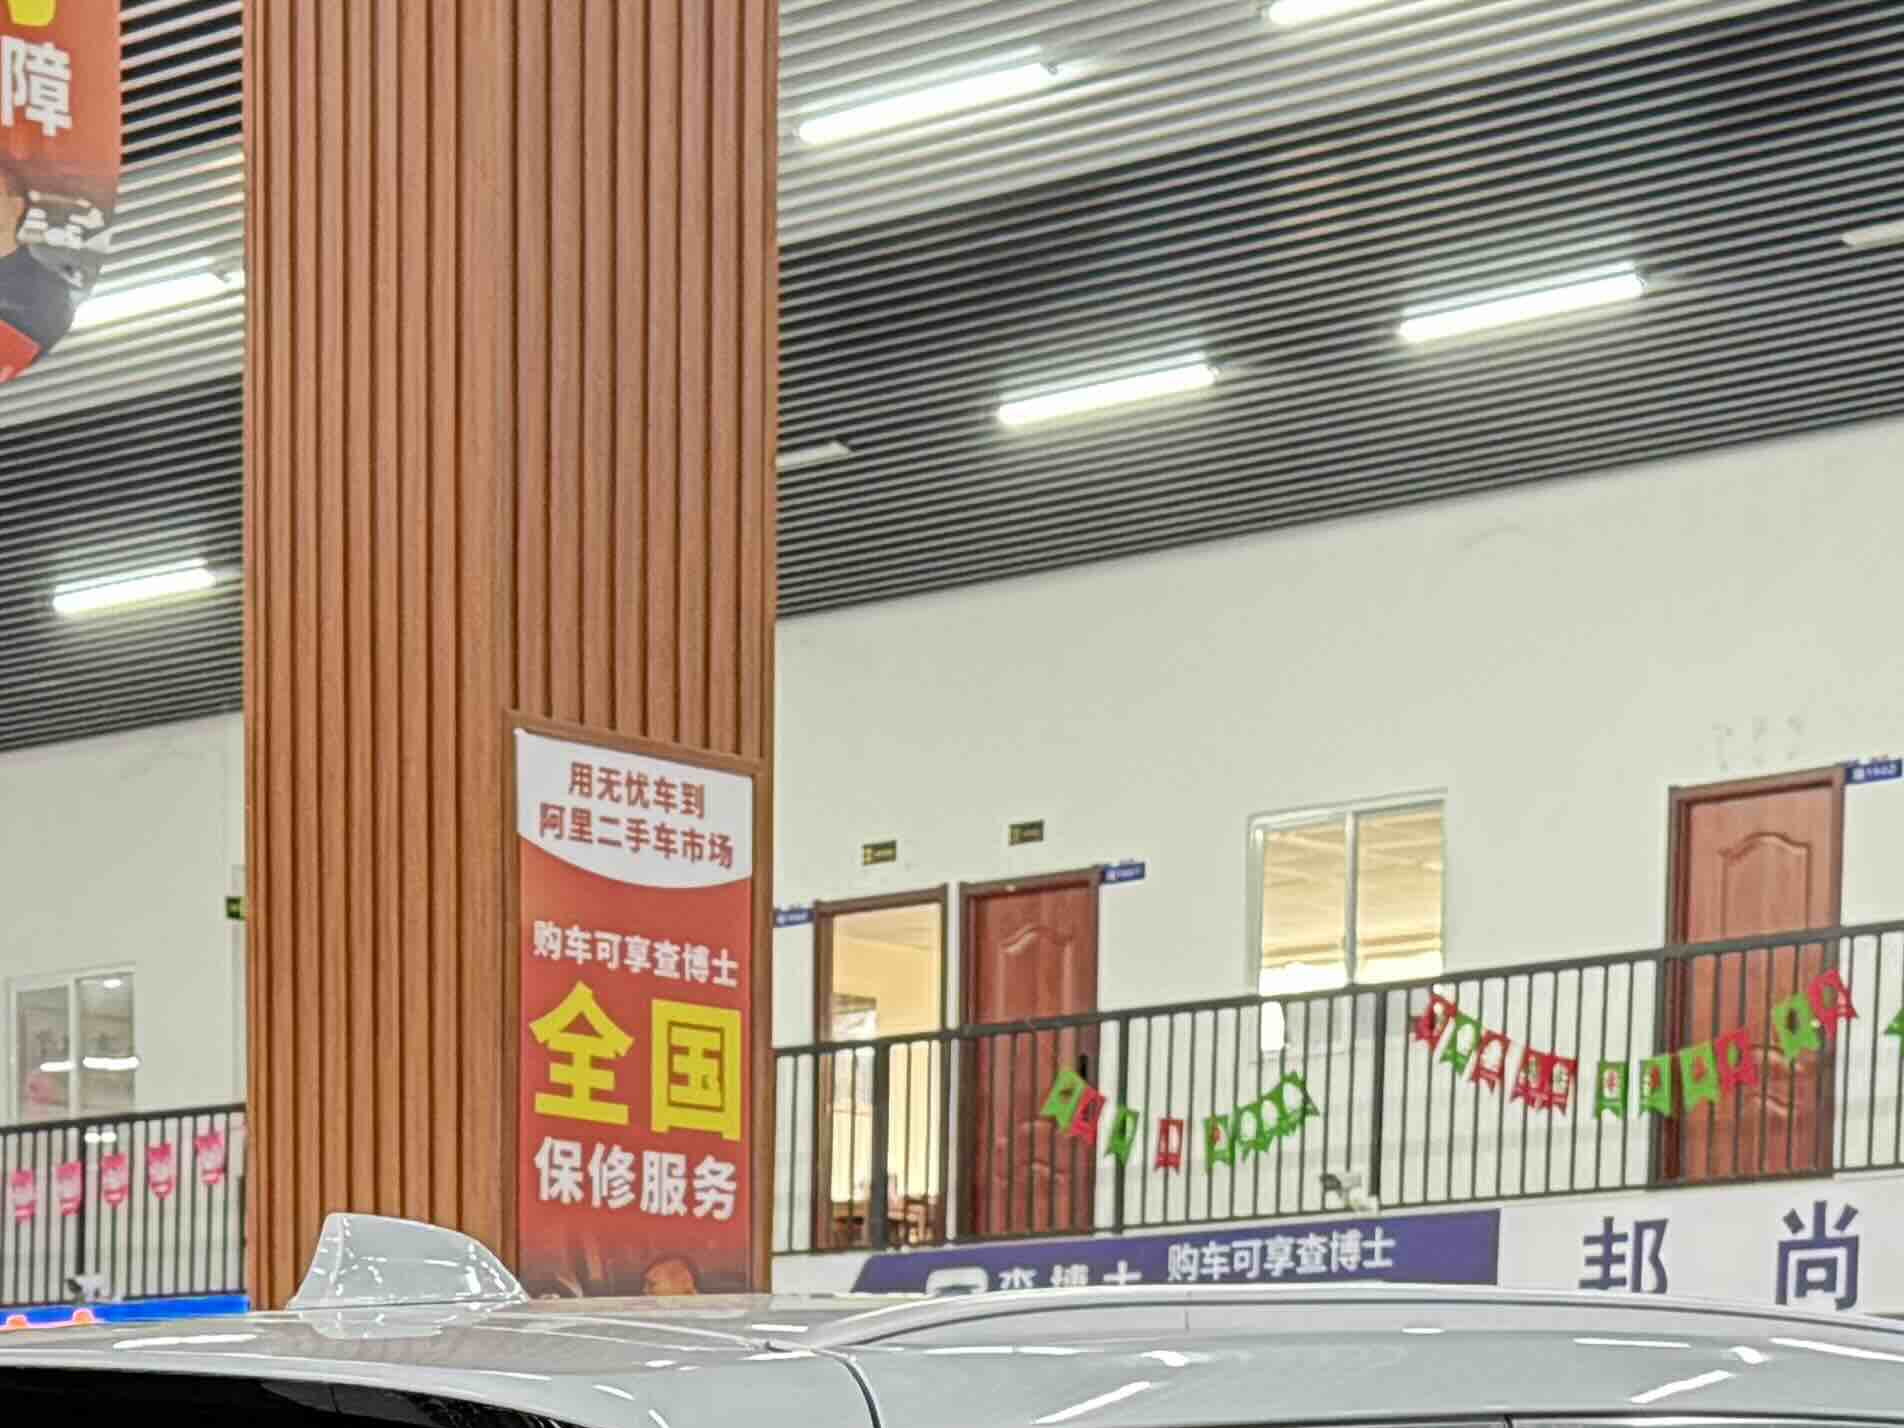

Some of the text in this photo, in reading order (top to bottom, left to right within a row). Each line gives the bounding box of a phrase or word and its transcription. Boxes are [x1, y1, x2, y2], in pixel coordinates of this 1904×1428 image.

[568, 761, 706, 820] 用无忧车到
[539, 803, 734, 869] 阿里二手车市场
[532, 920, 739, 988] 购车可享查博士
[529, 981, 742, 1142] 全国
[534, 1136, 738, 1221] 保修服务
[1167, 1228, 1395, 1282] 购车可享查博士
